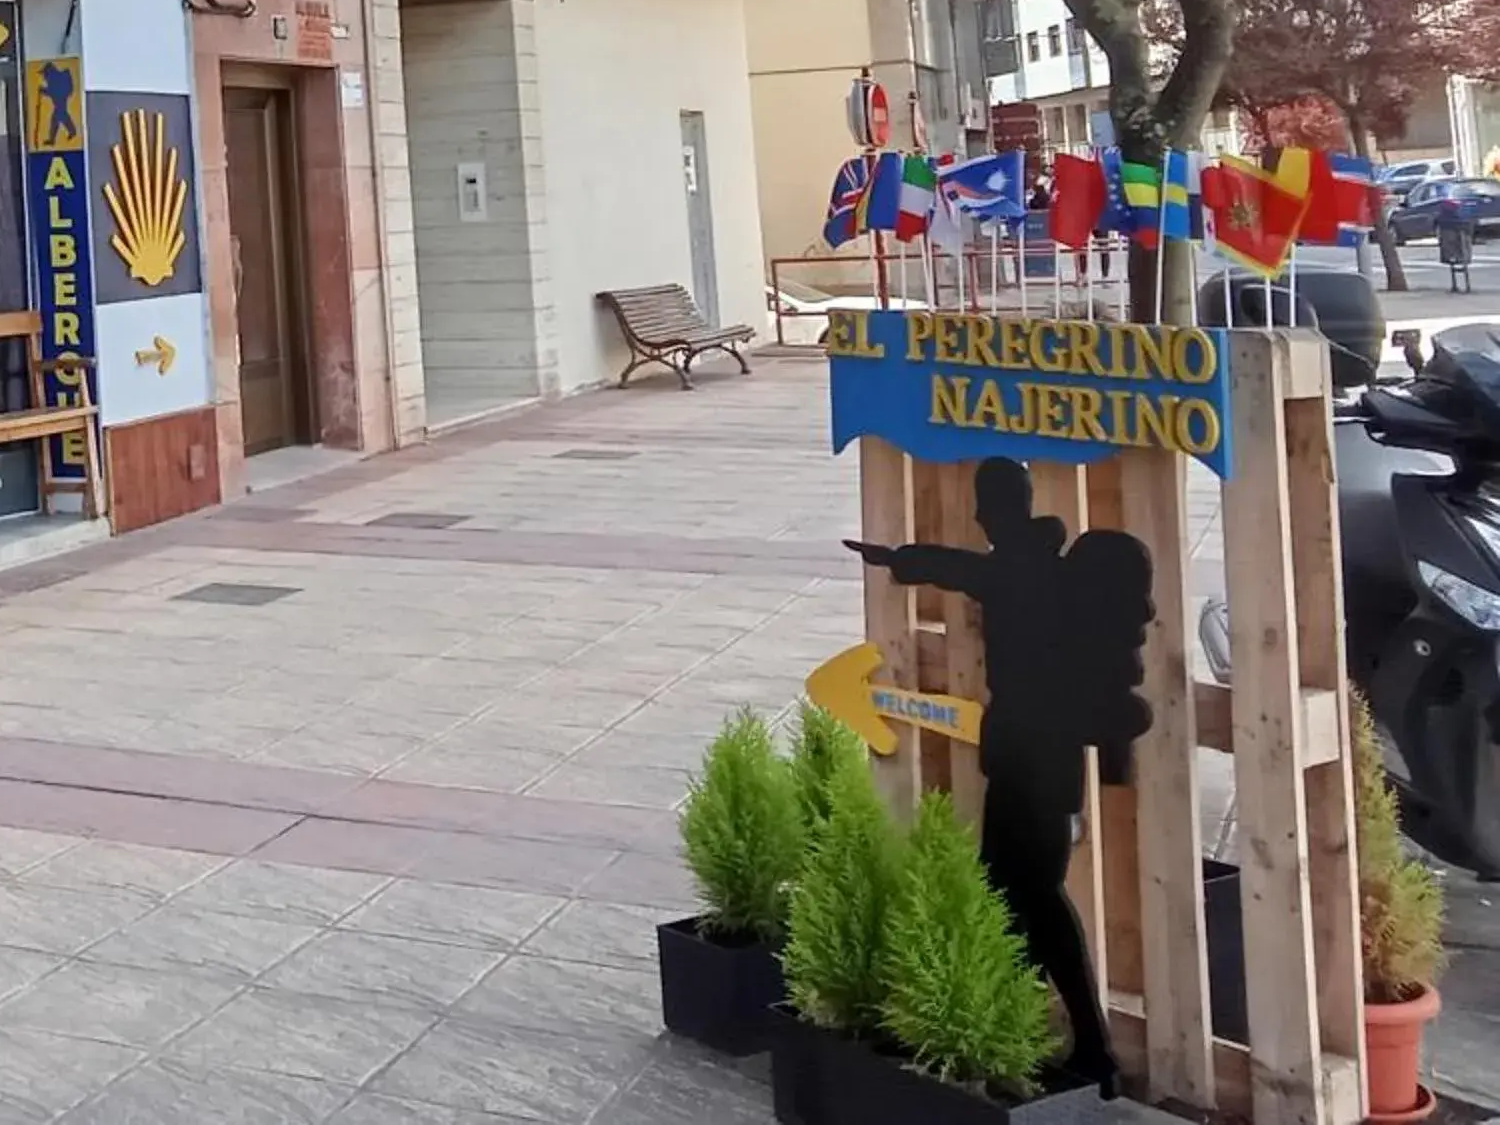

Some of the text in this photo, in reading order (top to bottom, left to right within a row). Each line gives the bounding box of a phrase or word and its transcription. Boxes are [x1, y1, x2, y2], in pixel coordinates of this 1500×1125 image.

[827, 309, 1218, 384] EL PEREGRINO
[928, 373, 1221, 455] NAJERINO
[872, 689, 959, 729] WELCOME
